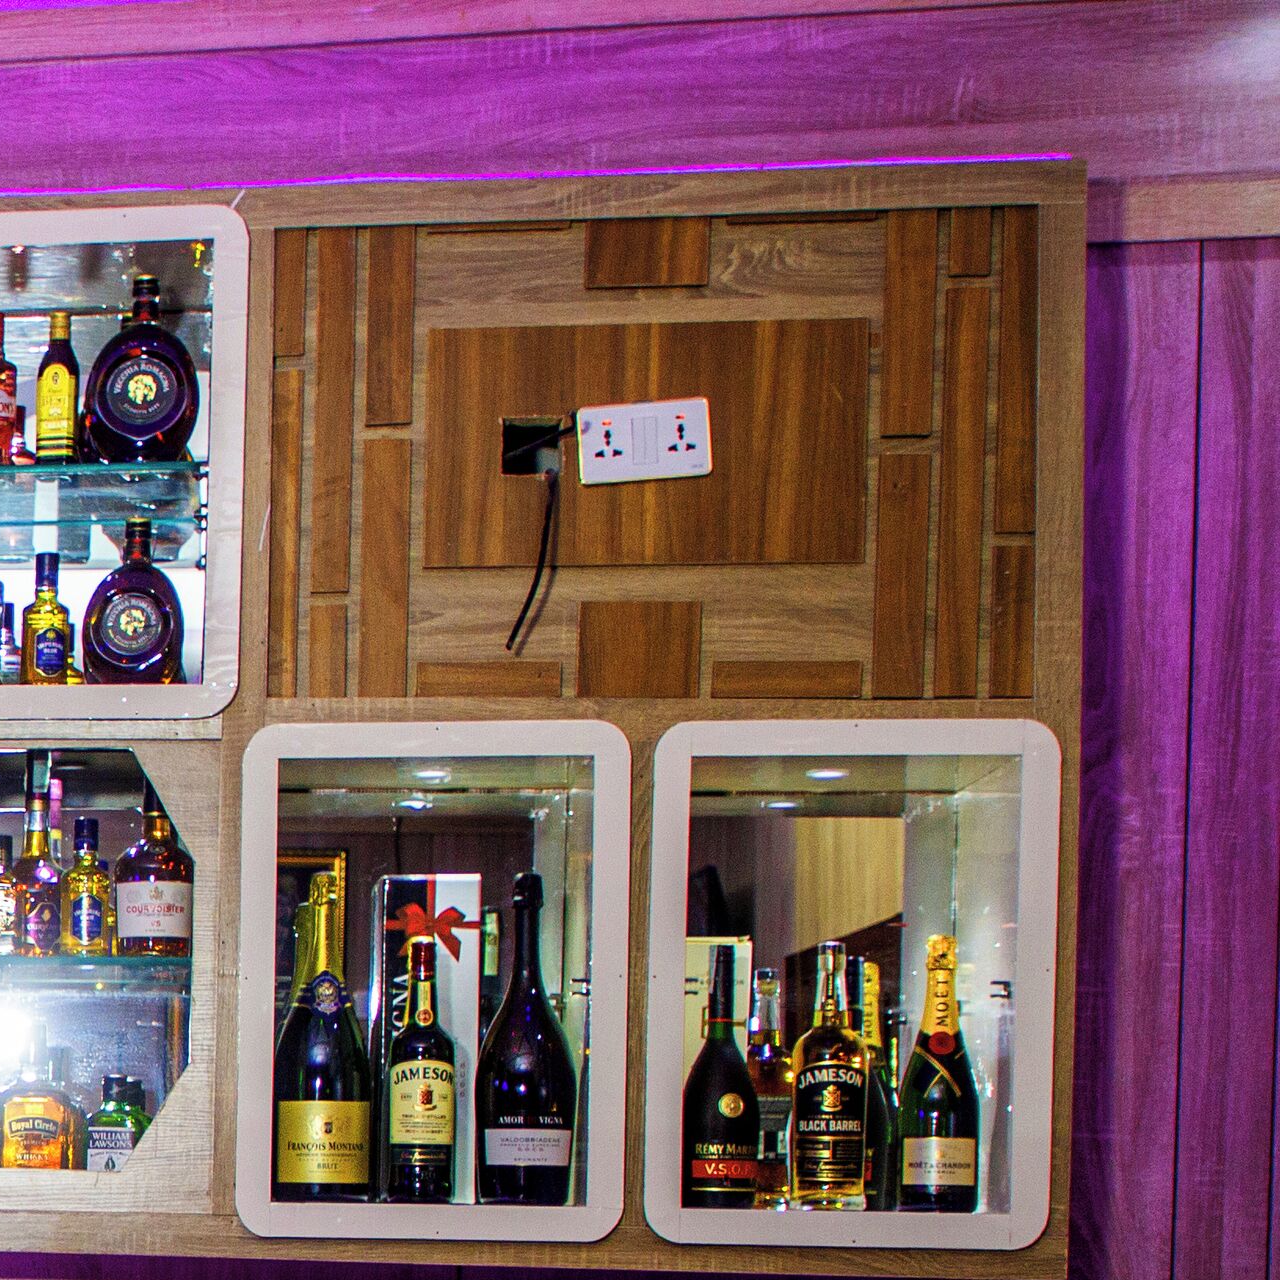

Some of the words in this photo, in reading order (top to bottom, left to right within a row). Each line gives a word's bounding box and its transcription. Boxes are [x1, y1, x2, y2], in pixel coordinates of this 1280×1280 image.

[394, 1067, 456, 1085] JAMESON
[798, 1068, 863, 1089] JAMESON
[10, 1119, 33, 1132] Royal
[34, 1118, 57, 1132] Circle
[498, 1115, 524, 1124] AMOR
[538, 1115, 563, 1125] VIGNA
[799, 1119, 827, 1132] BLACK
[829, 1119, 861, 1132] BARREL
[92, 1131, 130, 1140] WILLIAM
[89, 1139, 133, 1148] LAWSON'S
[695, 1142, 724, 1154] RÉMY
[316, 1162, 338, 1170] BRUT
